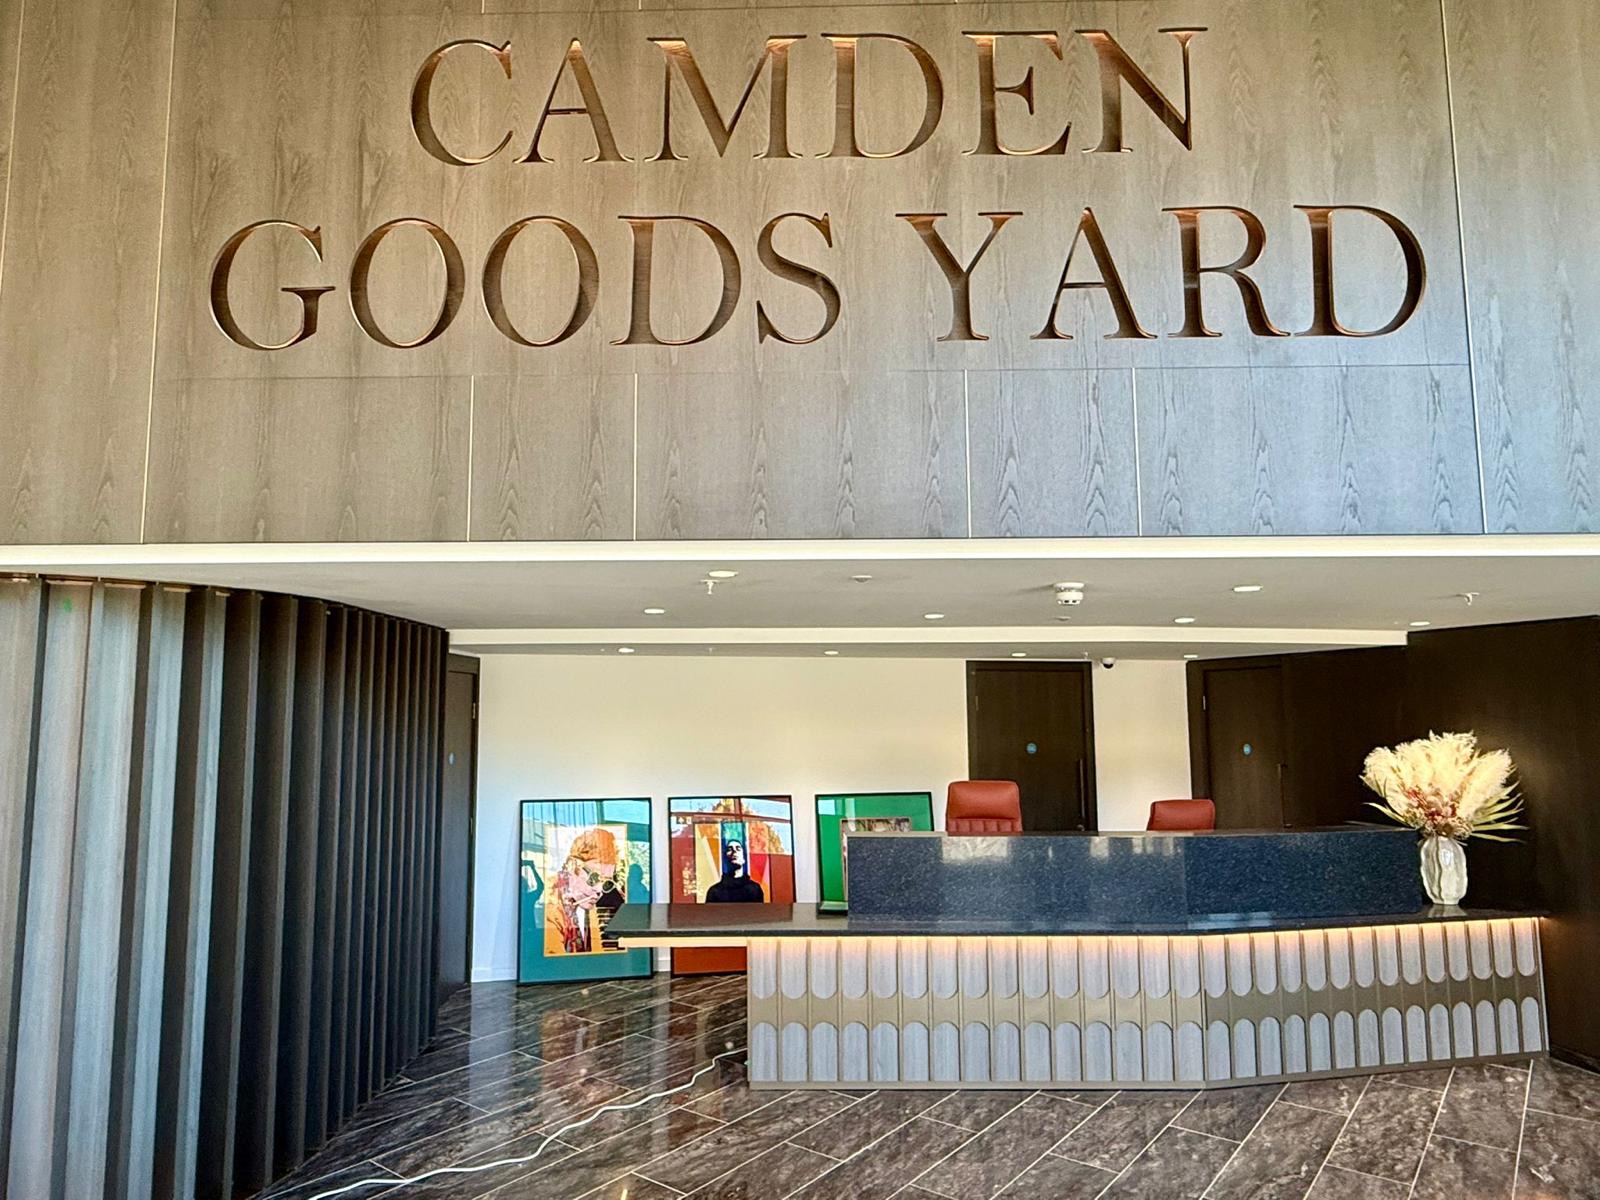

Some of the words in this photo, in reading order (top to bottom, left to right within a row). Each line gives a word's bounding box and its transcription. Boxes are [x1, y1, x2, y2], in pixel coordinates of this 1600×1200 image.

[410, 27, 1208, 166] CAMDEN
[210, 212, 841, 350] GOODS
[895, 205, 1427, 341] YARD
